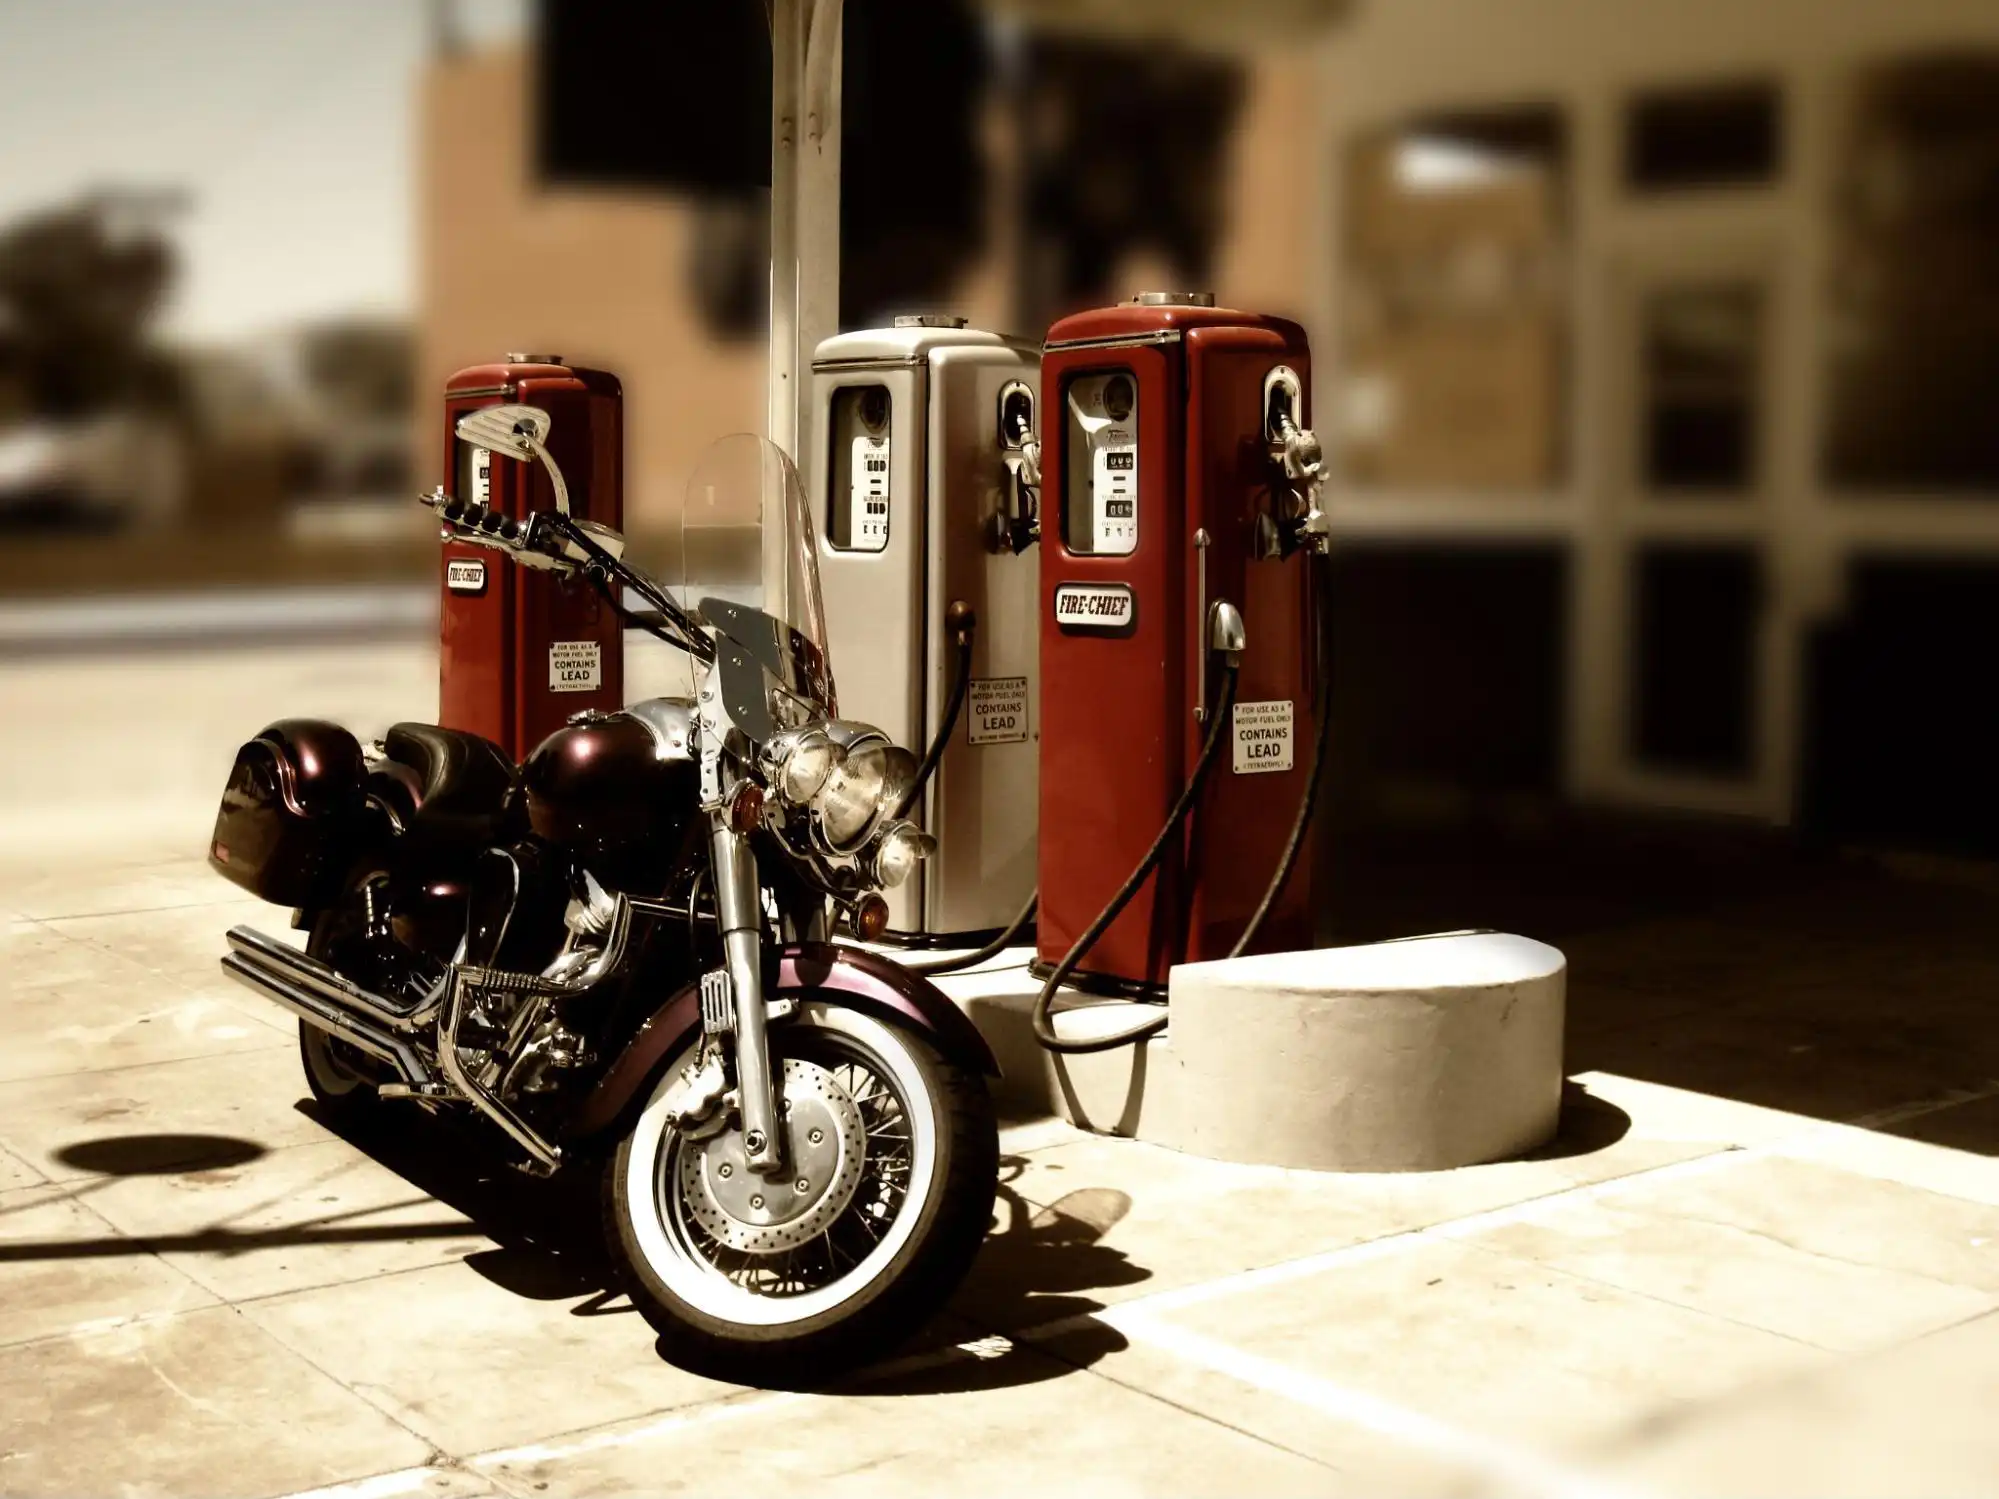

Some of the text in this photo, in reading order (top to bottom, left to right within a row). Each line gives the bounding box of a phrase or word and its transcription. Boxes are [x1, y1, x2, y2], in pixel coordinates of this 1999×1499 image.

[1059, 594, 1129, 616] FIRE-CHIEF
[554, 660, 596, 669] CONTAINS
[561, 670, 590, 681] LEAD
[975, 702, 1022, 715] CONTAINS
[1242, 706, 1255, 714] FOR
[1256, 705, 1269, 713] USE
[1280, 704, 1285, 712] A
[983, 716, 1016, 730] LEAD
[1235, 716, 1258, 725] MOTOR
[1259, 715, 1274, 724] FUEL
[1240, 727, 1288, 741] CONTAINS
[1247, 743, 1281, 758] LEAD
